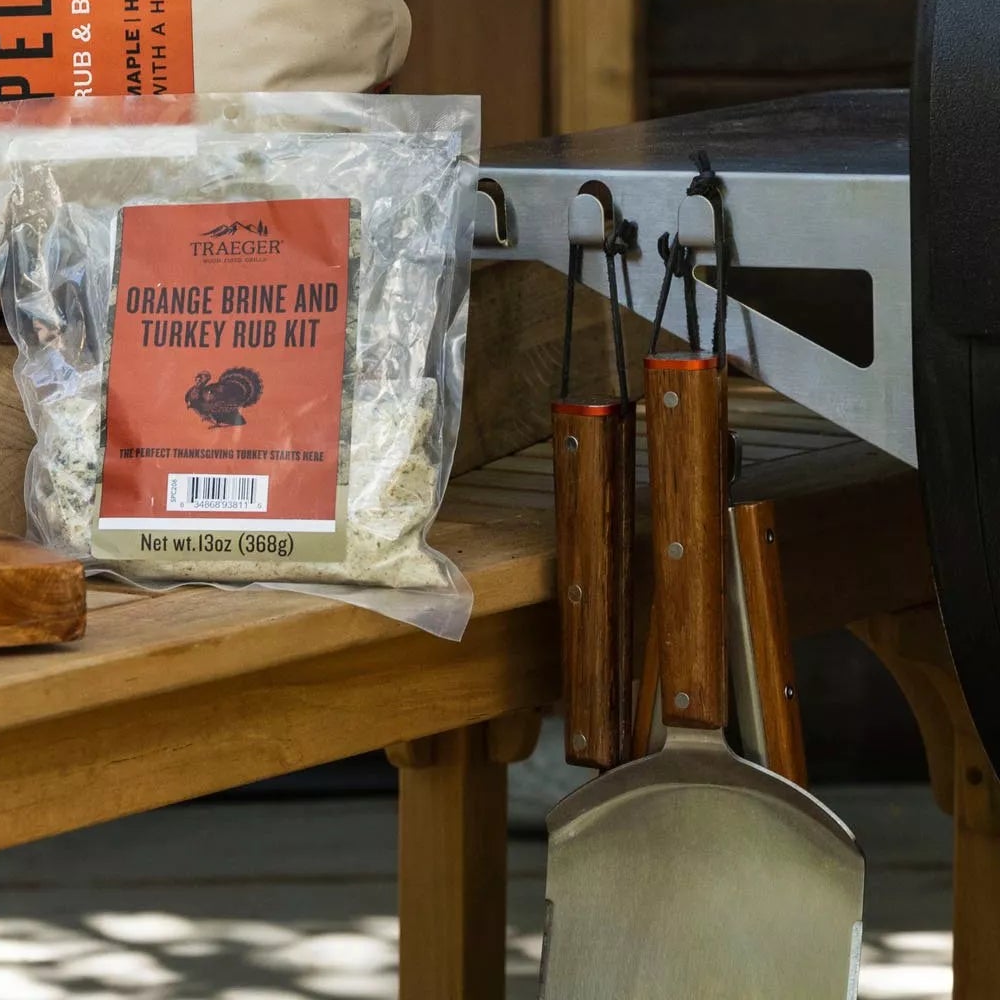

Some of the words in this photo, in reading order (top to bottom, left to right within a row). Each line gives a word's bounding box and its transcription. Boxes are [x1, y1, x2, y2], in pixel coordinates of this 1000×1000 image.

[71, 23, 91, 42] &
[151, 22, 166, 35] A
[72, 51, 93, 98] RUB
[126, 286, 214, 314] ORANGE
[221, 284, 288, 314] BRINE
[294, 282, 339, 313] AND
[141, 320, 226, 348] TURKEY
[233, 320, 276, 348] RUB
[284, 319, 321, 348] KIT
[119, 448, 134, 459] THE
[135, 448, 171, 459] PERFECT
[173, 448, 234, 459] THANKSGIVING
[236, 449, 268, 460] TURKEY
[269, 450, 301, 461] STARTS
[302, 450, 325, 462] HERE
[140, 533, 168, 551] Net
[238, 532, 294, 556] (368g)
